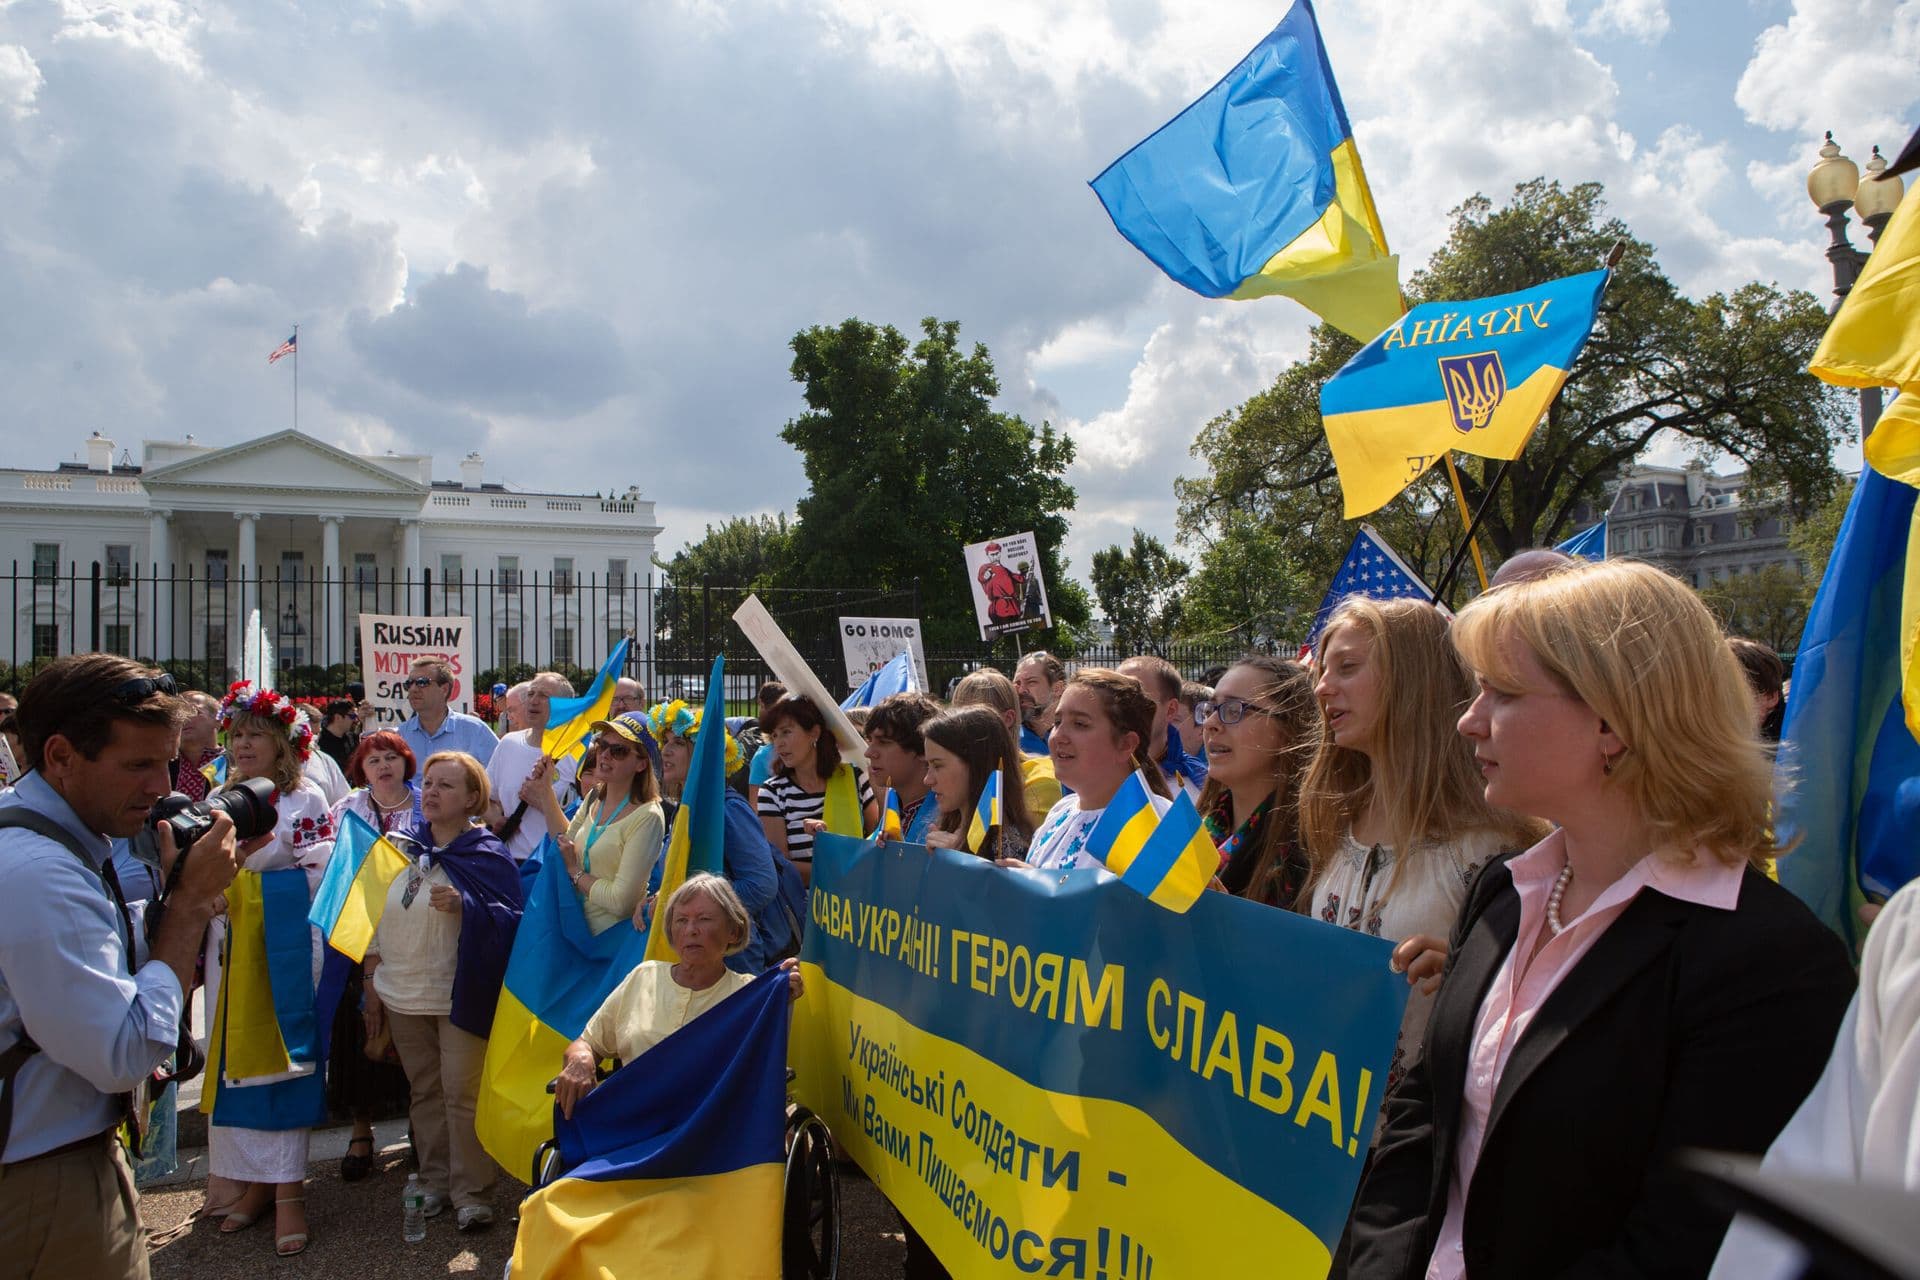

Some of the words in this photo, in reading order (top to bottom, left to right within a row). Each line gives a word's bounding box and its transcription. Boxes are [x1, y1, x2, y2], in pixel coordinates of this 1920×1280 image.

[374, 622, 461, 647] RUSSIAN
[845, 624, 866, 637] GO
[812, 886, 854, 943] САВА
[951, 929, 1125, 1031] ГЕРОЯМ
[1146, 977, 1373, 1158] СЛАВА!
[850, 1020, 945, 1117] Українські
[951, 1079, 1080, 1192] Солдати
[1108, 1170, 1127, 1187] -
[863, 1093, 911, 1168] Вами
